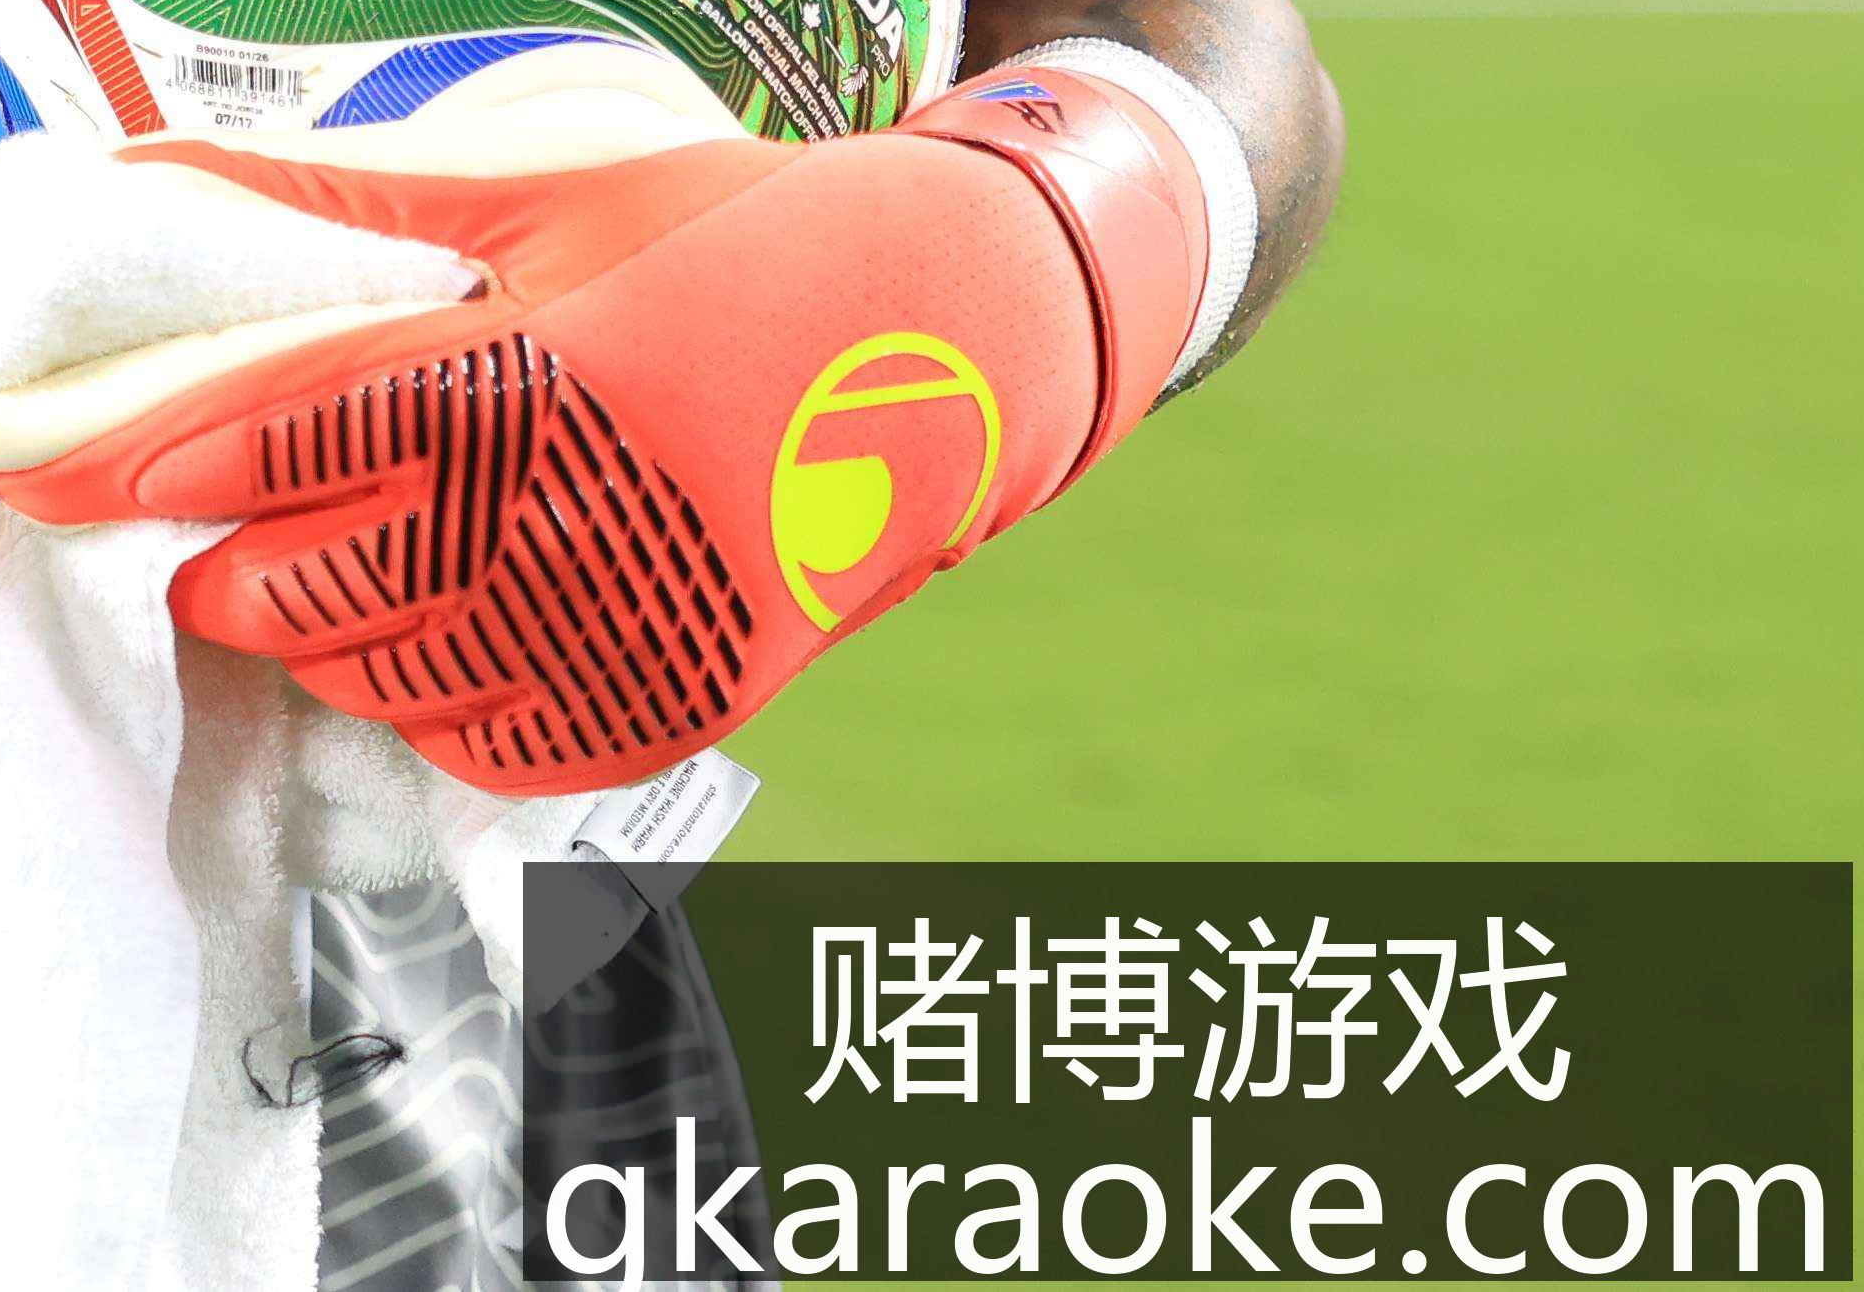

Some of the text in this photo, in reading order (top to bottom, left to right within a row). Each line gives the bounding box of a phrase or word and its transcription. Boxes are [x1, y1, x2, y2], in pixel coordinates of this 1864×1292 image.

[239, 50, 270, 63] 01/26
[701, 0, 820, 144] BALLON DE MATCH OFFIC
[743, 19, 789, 78] OFFICIAL
[789, 73, 825, 122] MATCH
[764, 14, 804, 66] OFICIAL
[801, 60, 820, 89] DEL
[817, 83, 849, 136] PARTIDO
[870, 45, 890, 77] PRO
[631, 758, 700, 854] MACHINE WASH WARM
[646, 786, 661, 805] DRY
